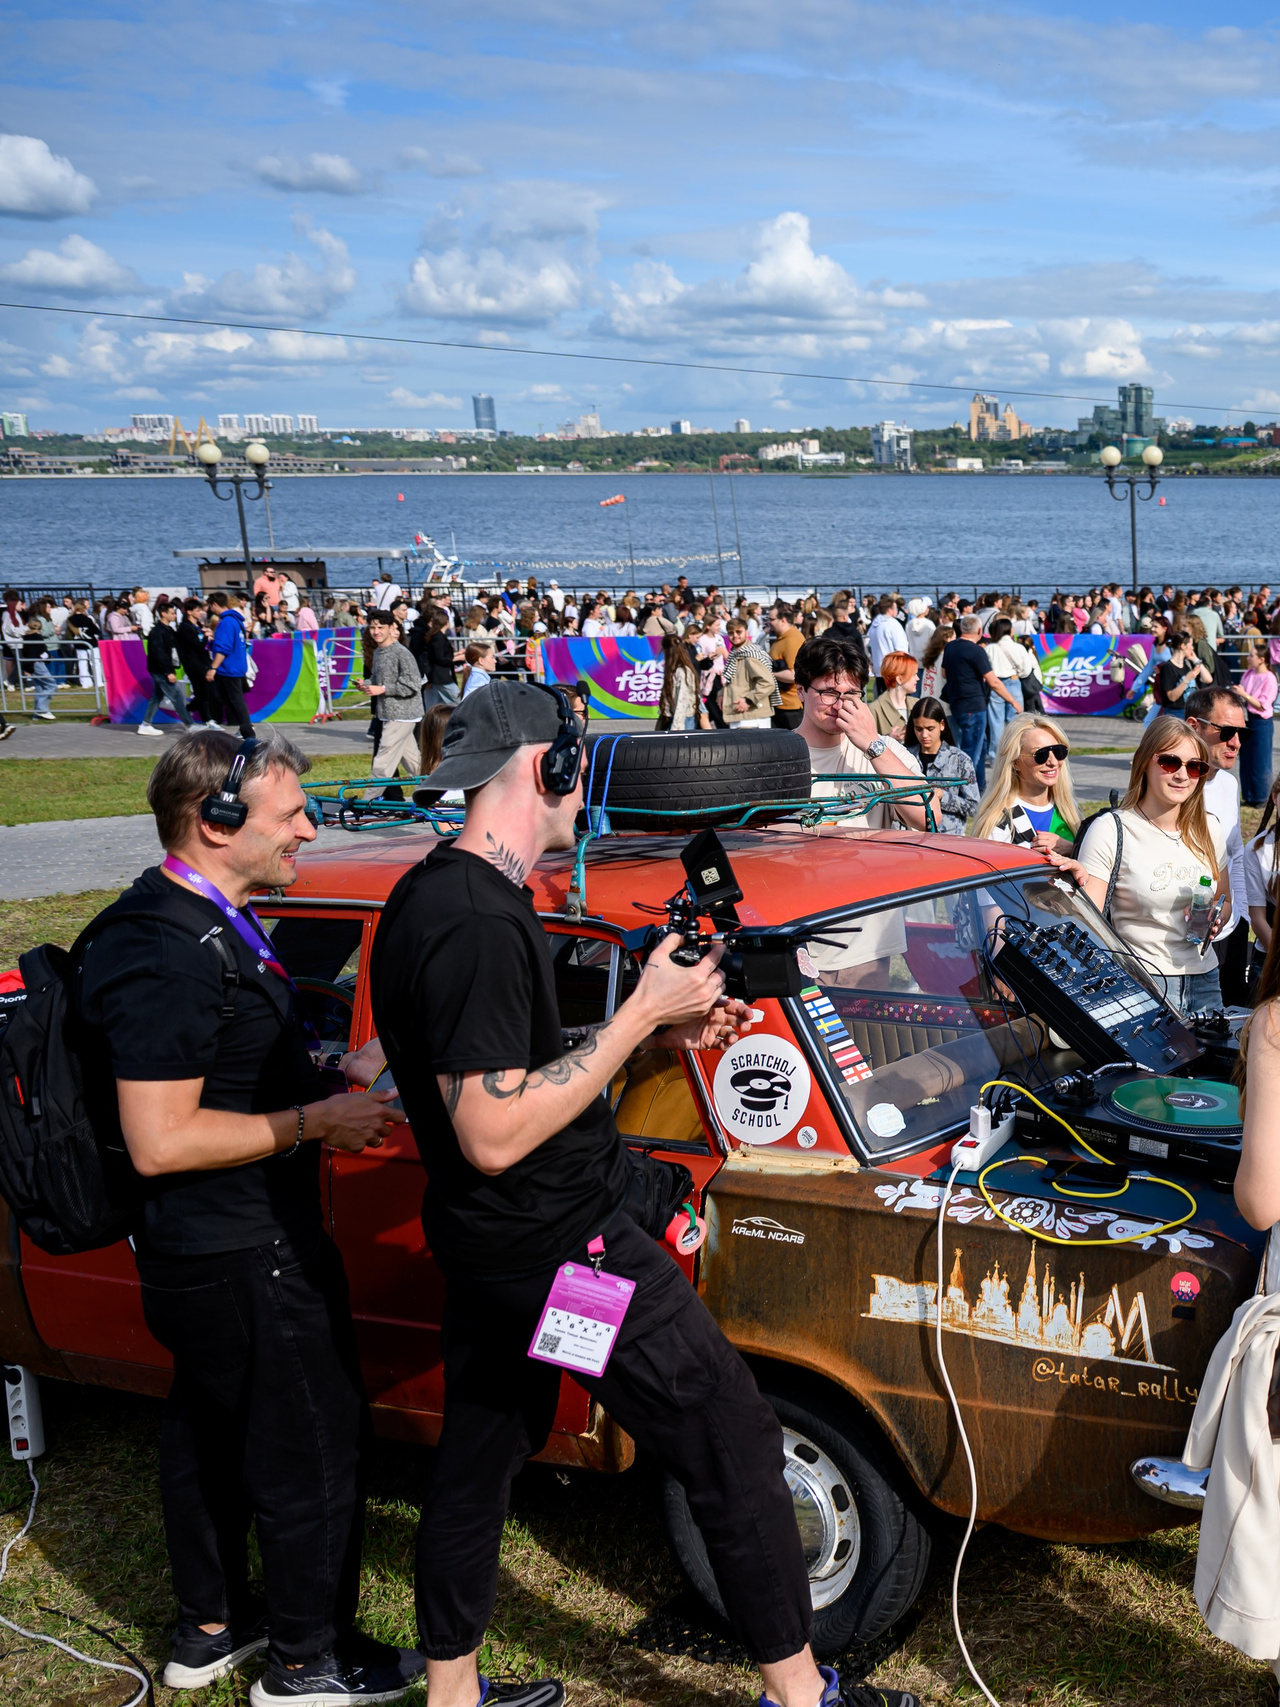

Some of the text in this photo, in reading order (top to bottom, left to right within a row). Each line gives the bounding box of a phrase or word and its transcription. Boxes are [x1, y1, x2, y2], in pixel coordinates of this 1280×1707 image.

[1062, 656, 1096, 671] VK
[615, 669, 664, 691] fes
[1043, 665, 1111, 686] fest
[1053, 686, 1090, 698] 2025
[732, 1108, 781, 1127] SCHOOL
